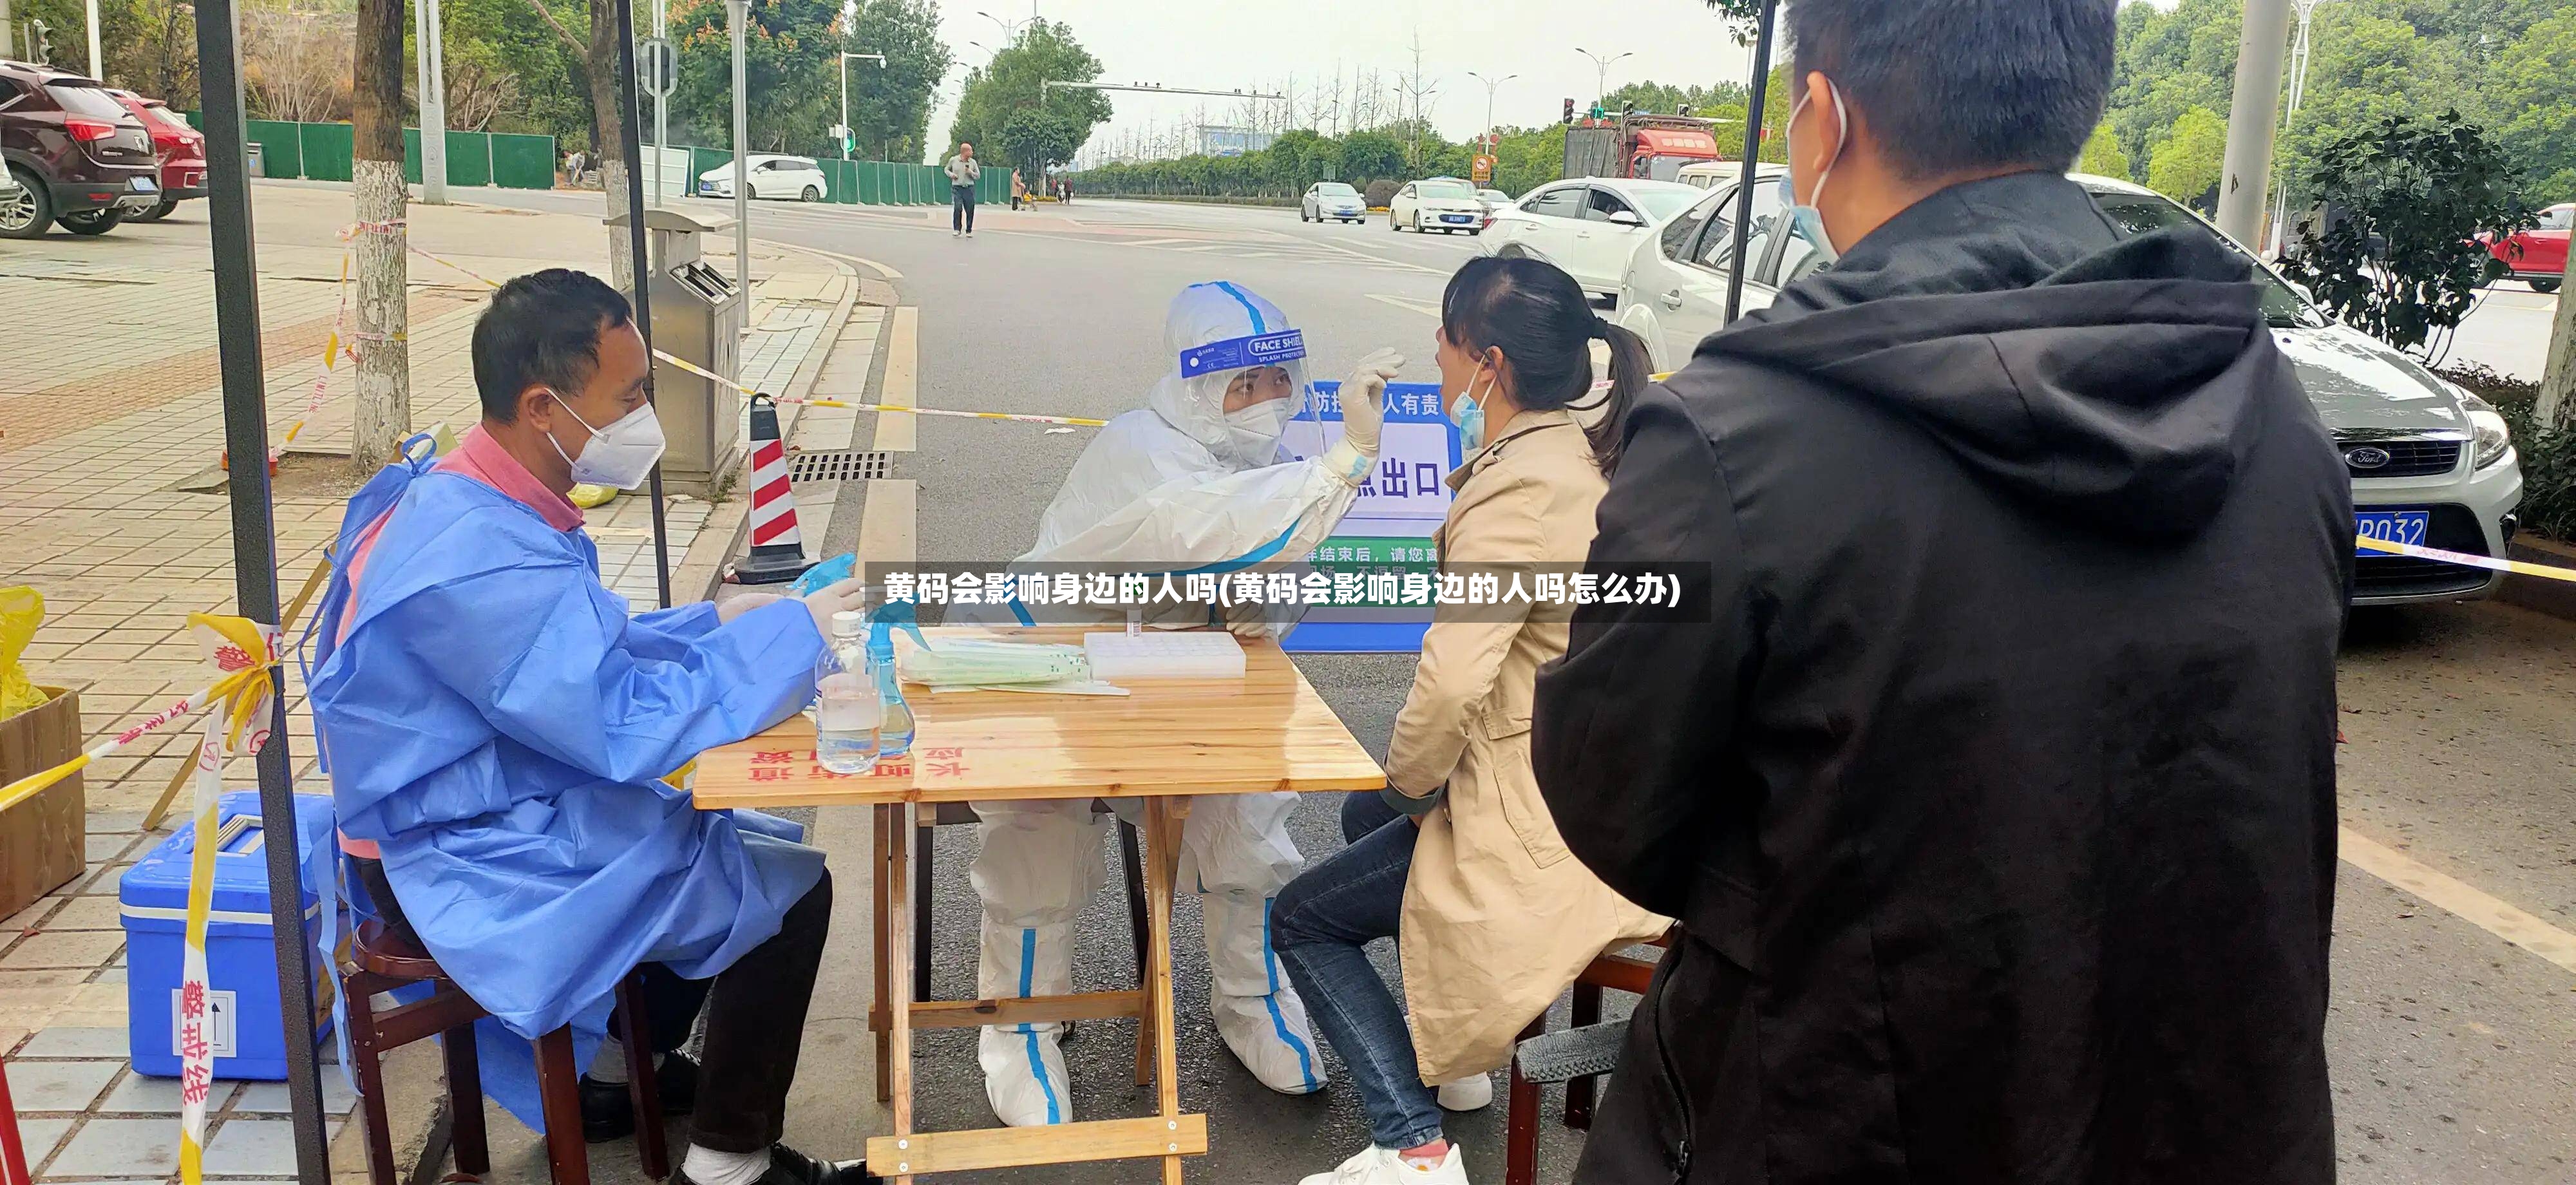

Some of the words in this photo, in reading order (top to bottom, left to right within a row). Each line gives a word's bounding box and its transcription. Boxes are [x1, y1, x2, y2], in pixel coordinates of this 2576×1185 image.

[1255, 339, 1281, 352] FACE
[1282, 336, 1303, 348] SHIEL
[1258, 354, 1281, 363] SPLASH
[2357, 450, 2382, 463] Ford
[2355, 518, 2425, 549] P032
[182, 979, 209, 1106] 警戒线
